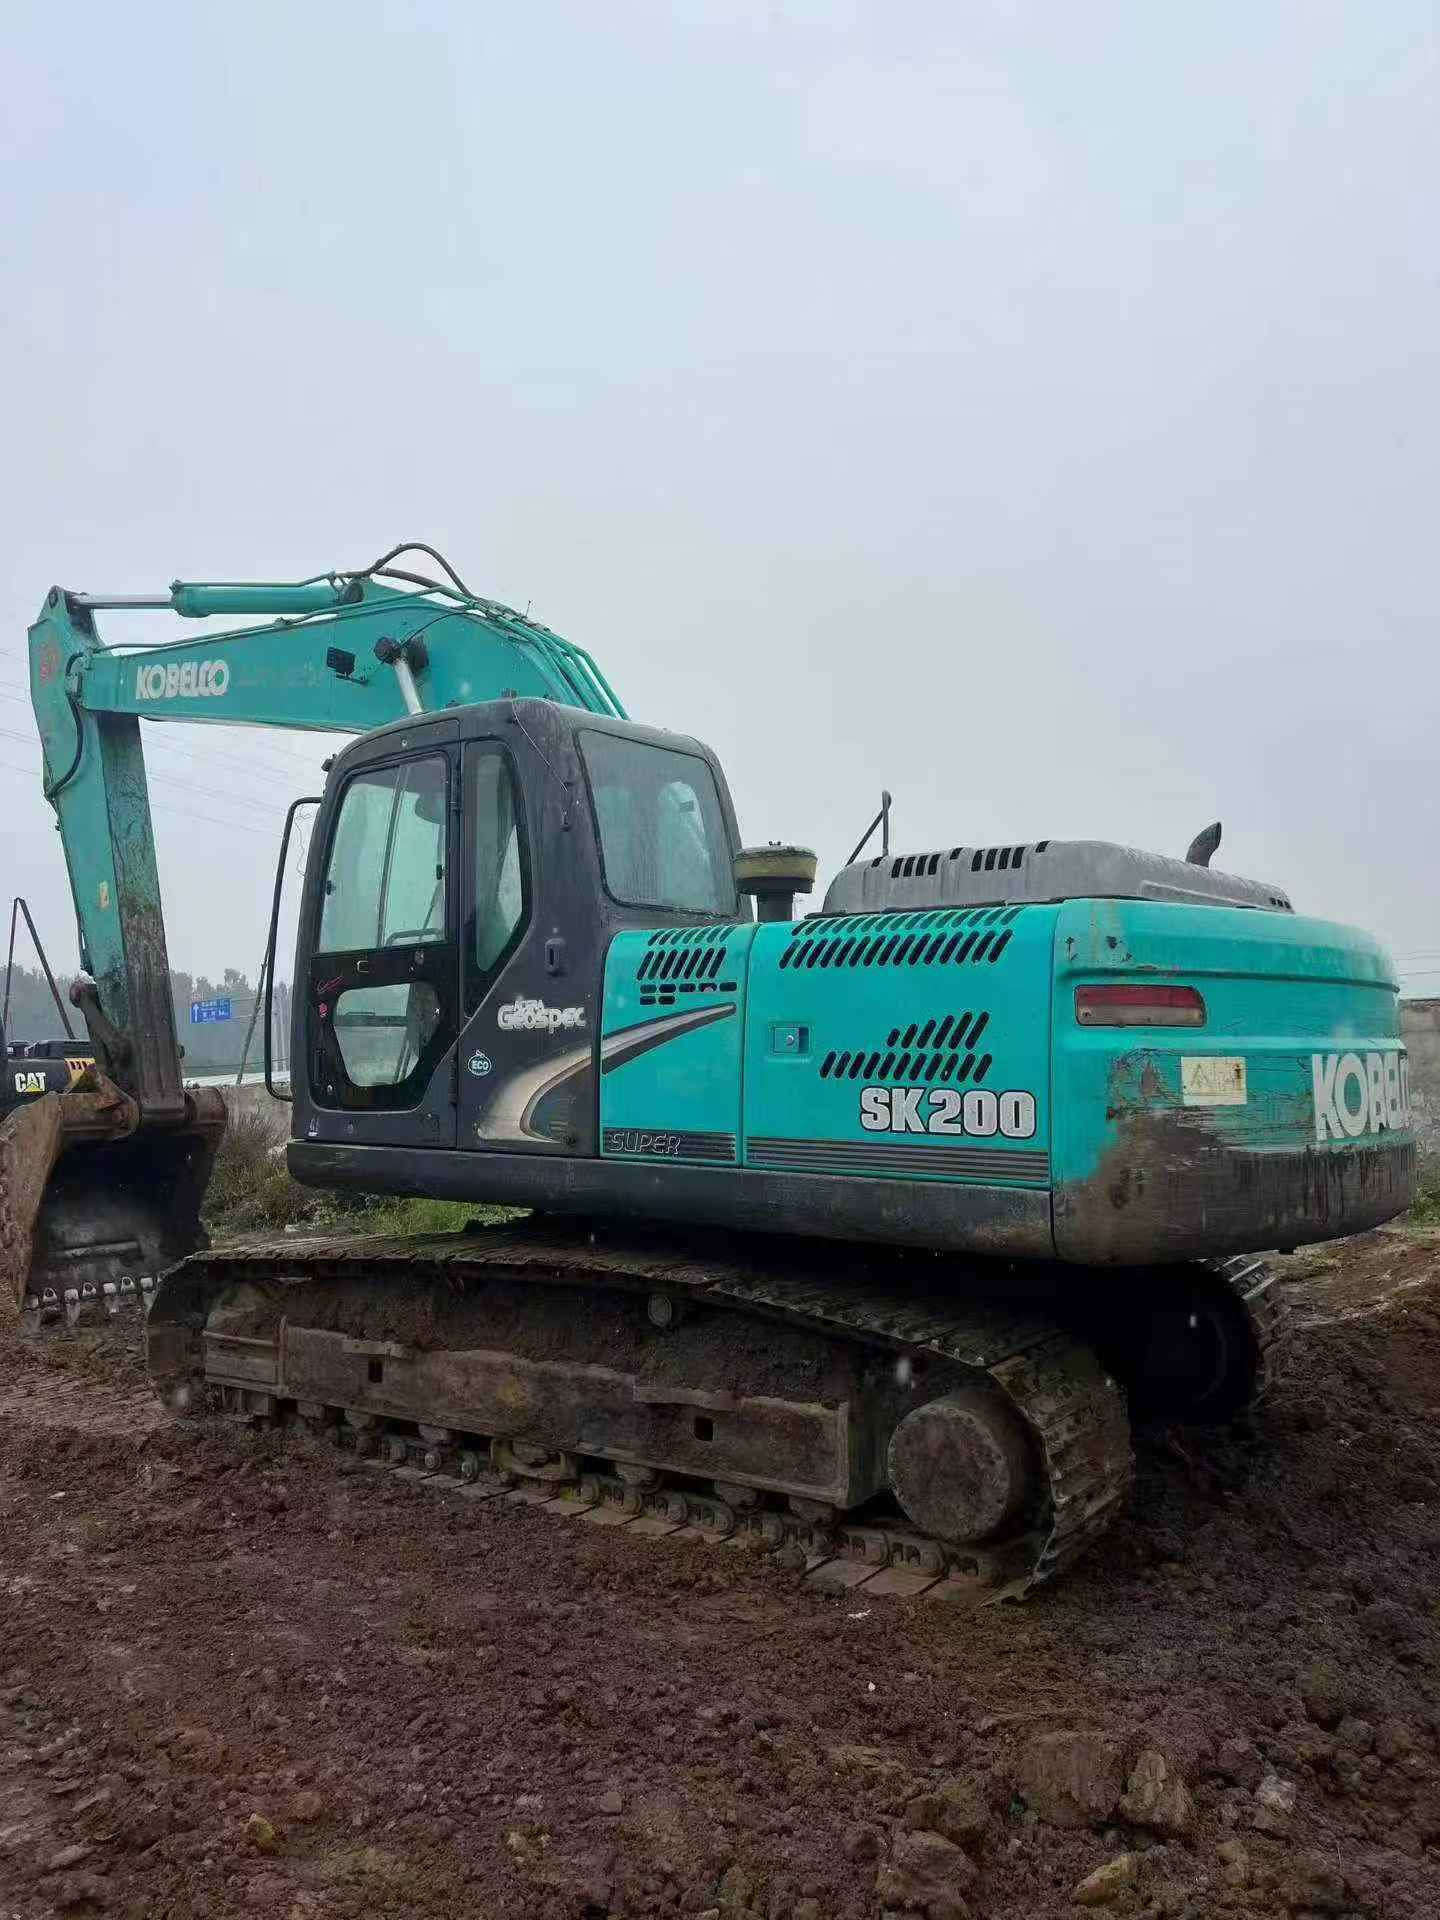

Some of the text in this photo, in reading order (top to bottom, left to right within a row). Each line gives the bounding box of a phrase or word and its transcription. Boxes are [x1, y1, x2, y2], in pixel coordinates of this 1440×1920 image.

[136, 659, 229, 700] KOBELCO
[472, 1061, 489, 1070] ECO
[15, 1072, 46, 1093] CAT
[860, 1085, 1037, 1139] SK200
[609, 1131, 681, 1155] SUPER
